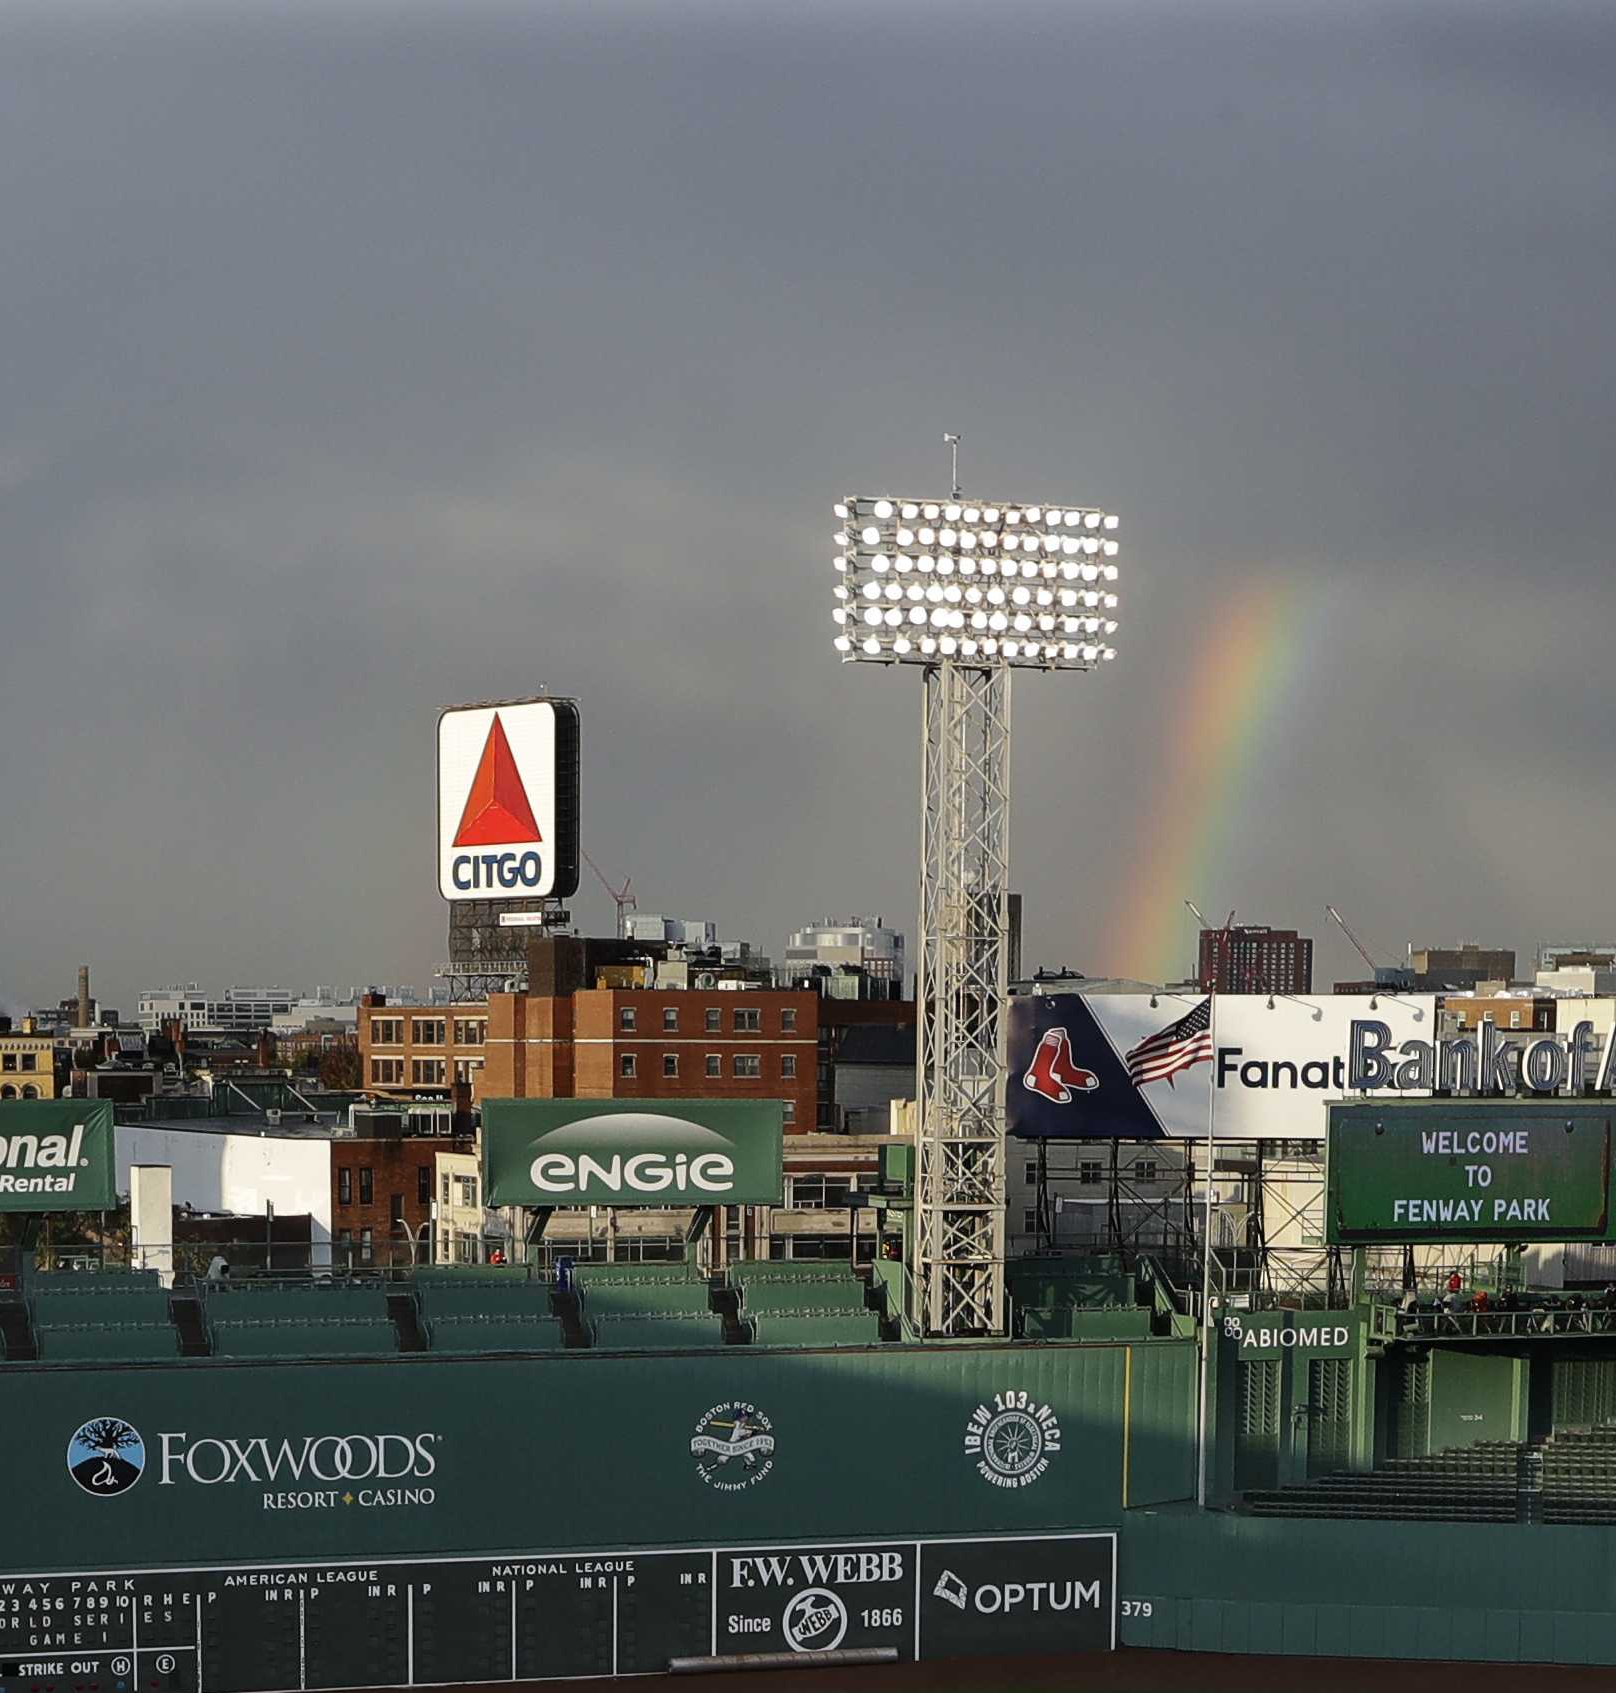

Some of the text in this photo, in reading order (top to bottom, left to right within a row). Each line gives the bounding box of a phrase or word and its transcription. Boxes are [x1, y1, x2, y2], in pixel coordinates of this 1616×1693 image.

[452, 851, 542, 890] CITGO
[1349, 1019, 1517, 1091] Bank
[1522, 1020, 1593, 1092] of
[1422, 1131, 1529, 1154] WELCOME
[1465, 1165, 1491, 1188] TO
[1394, 1198, 1551, 1223] FENWAY PARK
[1243, 1327, 1348, 1347] ABIOMED
[695, 1401, 754, 1433] BOSTON RED
[964, 1404, 992, 1455] IBEW
[994, 1390, 1028, 1412] 103
[1034, 1404, 1061, 1451] NECA
[157, 1432, 436, 1485] FOXWOODS
[714, 1460, 773, 1491] JIMMY FUND
[1019, 1457, 1050, 1486] BOSTON
[263, 1488, 436, 1509] RESORT CASINO
[224, 1571, 378, 1587] AMERICAN LEAGUE
[492, 1561, 634, 1576] NATIONAL LEAGUE
[729, 1552, 904, 1588] F.W. WEBB
[71, 1579, 135, 1592] PARK
[208, 1583, 431, 1603] P IN R P IN R P
[974, 1580, 1100, 1614] OPTUM
[1121, 1601, 1152, 1617] 379
[728, 1608, 903, 1636] Since WEBB 1866
[18, 1663, 64, 1676] STRIKE
[71, 1661, 100, 1674] OUT
